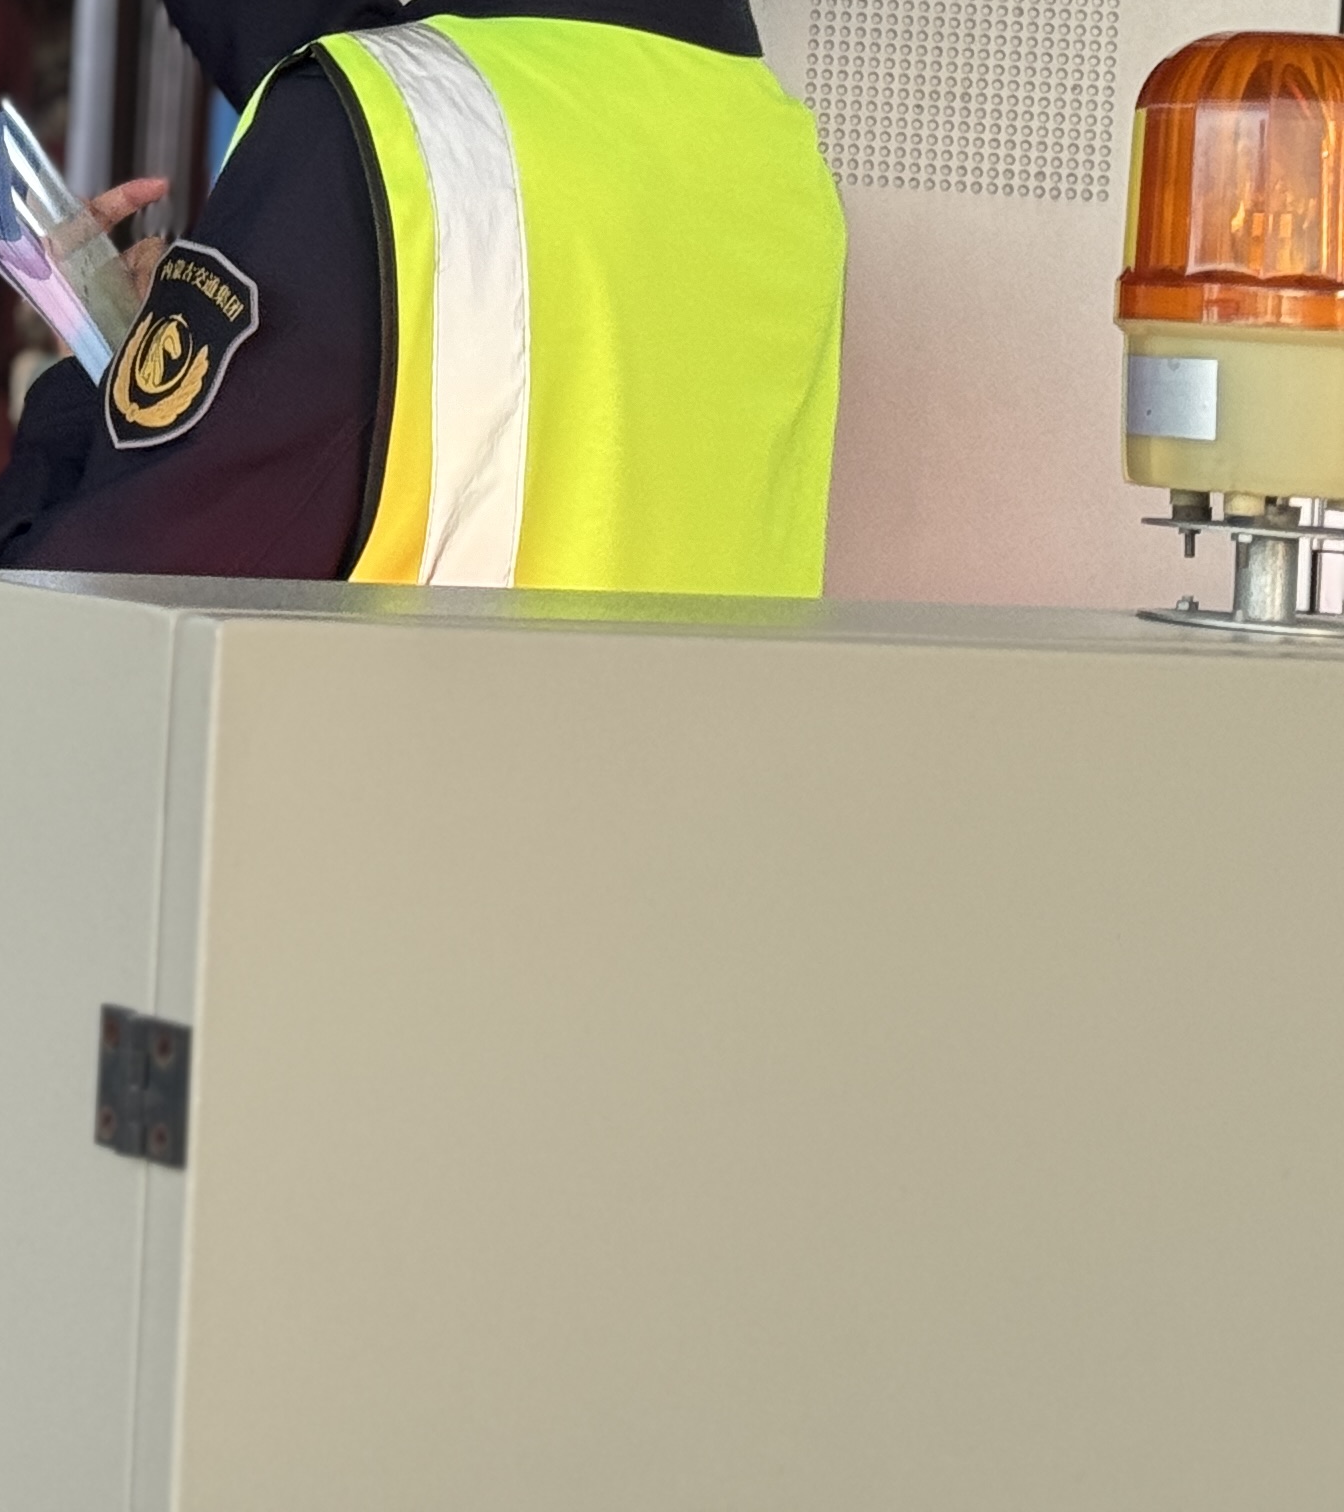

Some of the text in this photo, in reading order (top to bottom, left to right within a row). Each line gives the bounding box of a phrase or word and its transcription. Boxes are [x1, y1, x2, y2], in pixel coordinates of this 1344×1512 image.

[160, 259, 245, 323] 内蒙古交通集团
